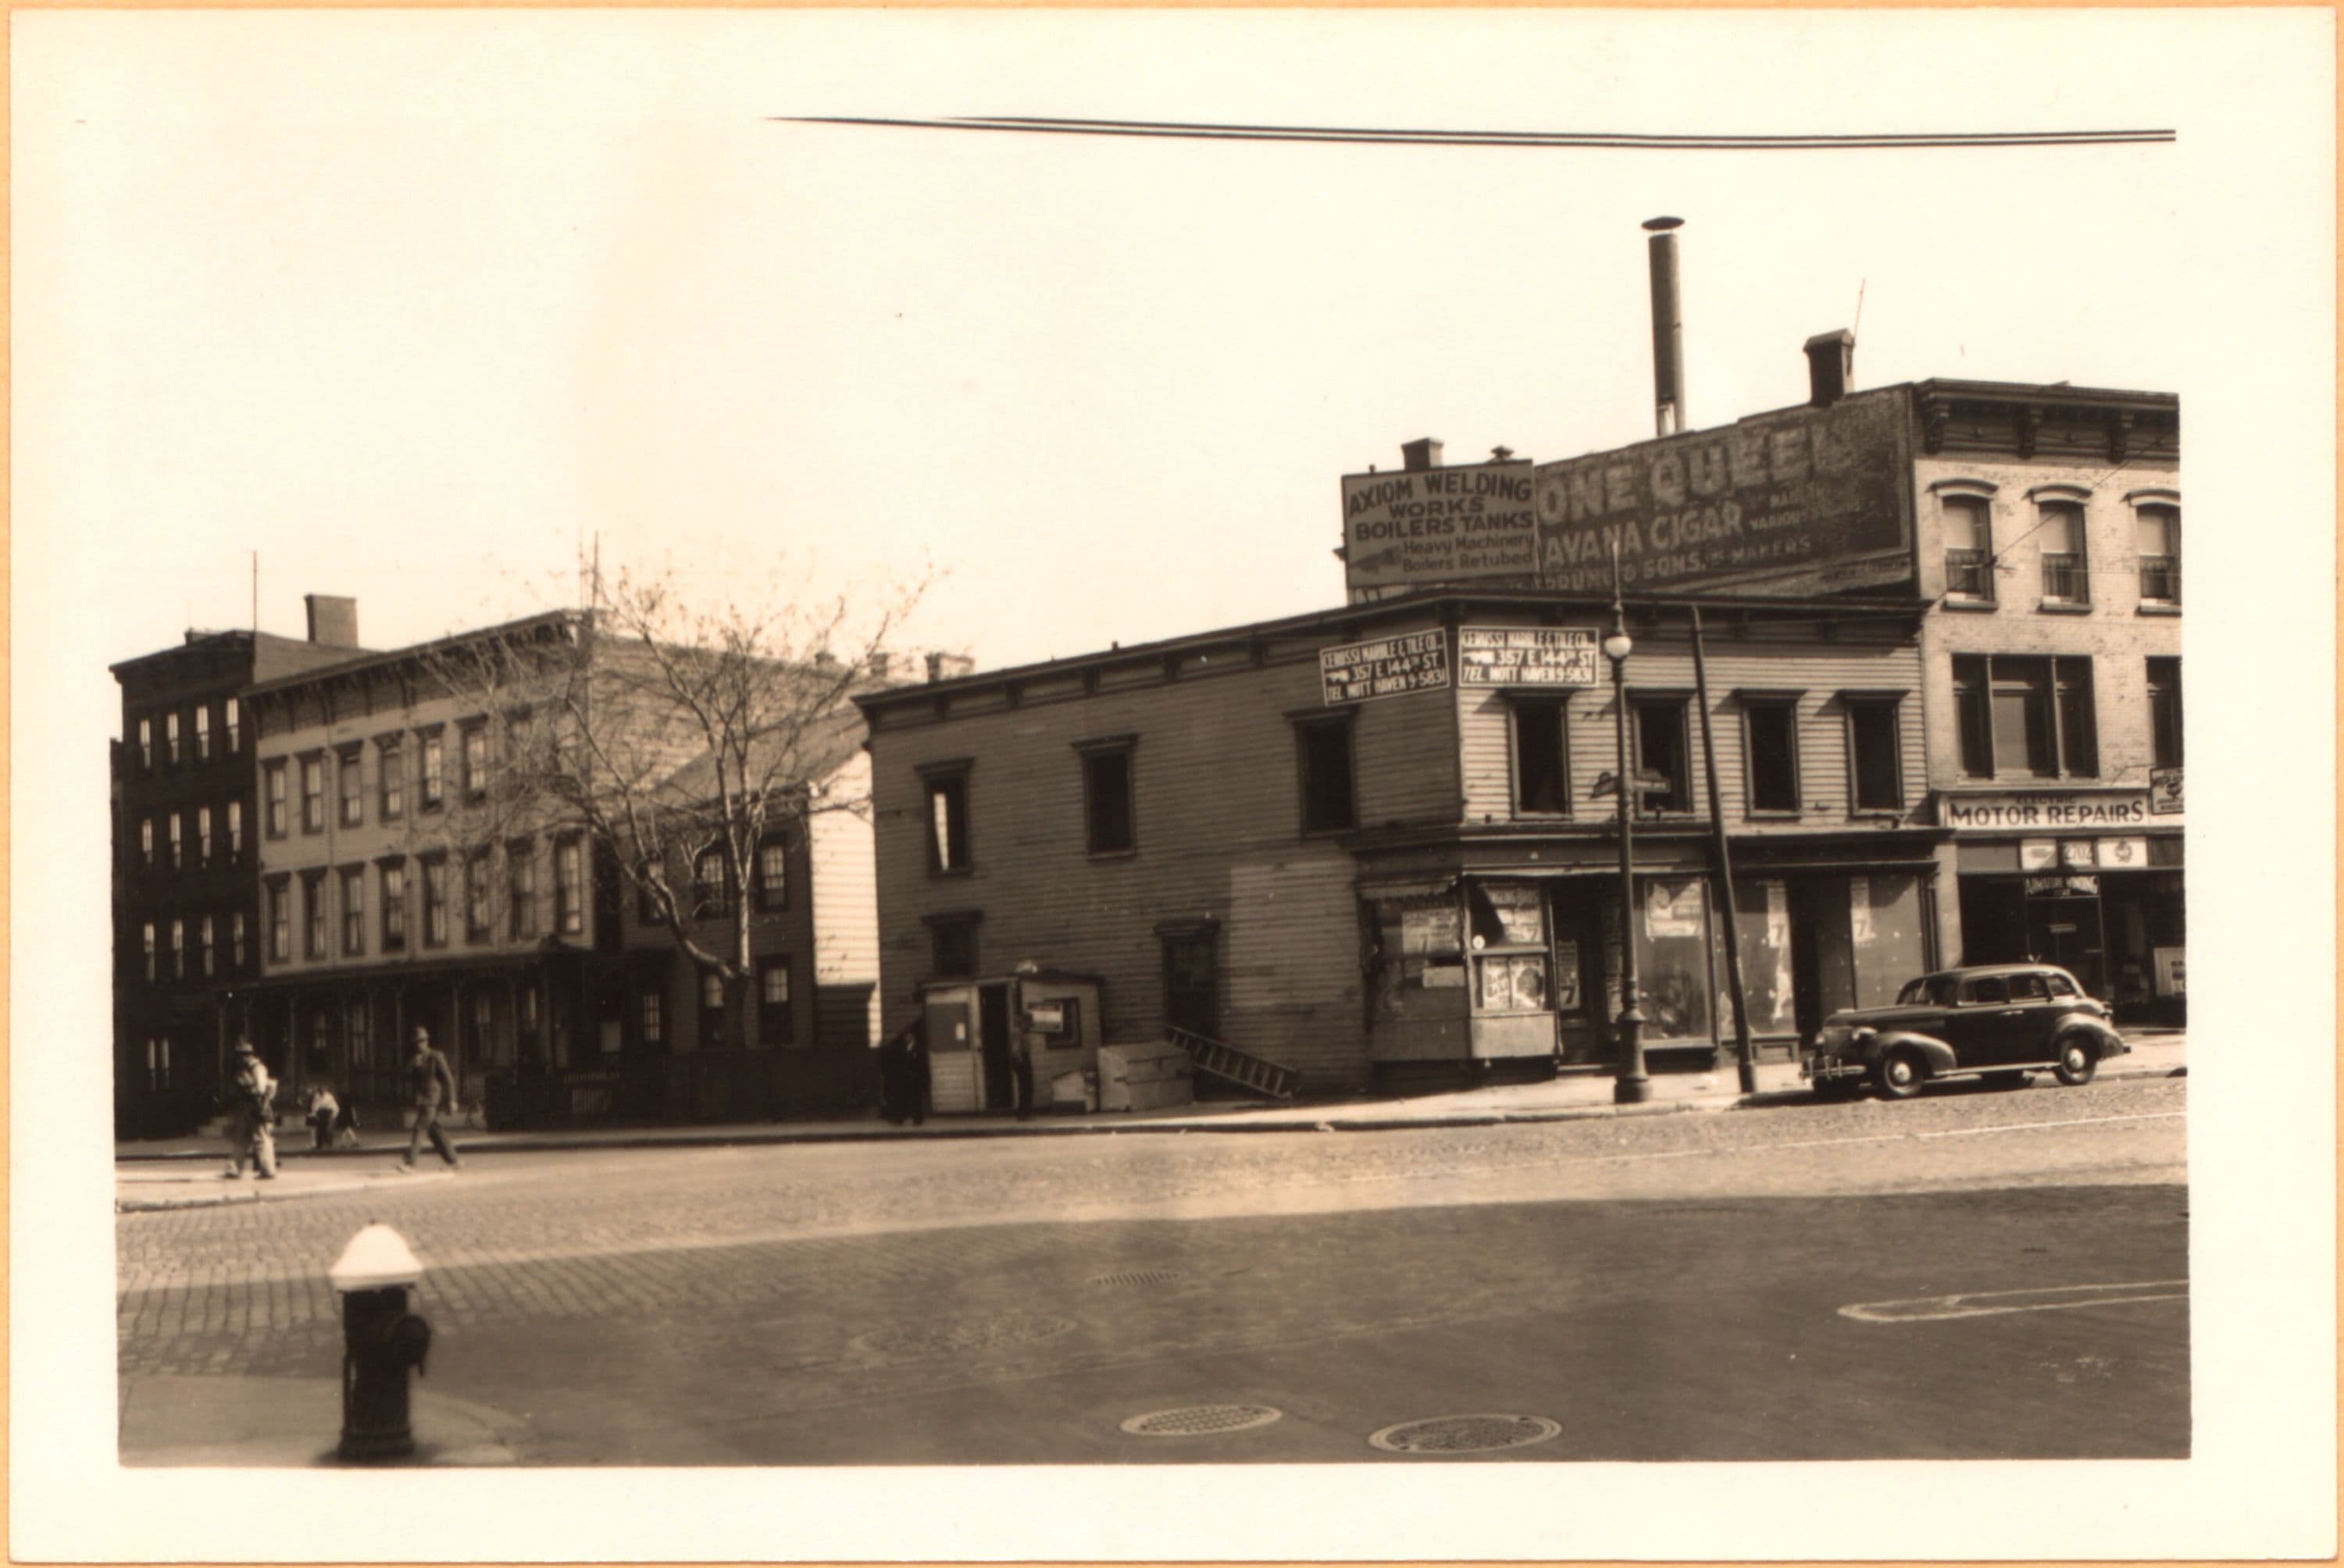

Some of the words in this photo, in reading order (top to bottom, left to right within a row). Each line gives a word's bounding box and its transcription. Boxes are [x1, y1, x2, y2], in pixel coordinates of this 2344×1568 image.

[1348, 477, 1414, 518] AXIOM
[1425, 472, 1533, 502] WELDING
[1389, 496, 1486, 519] WORKS
[1355, 516, 1455, 541] BOILERS
[1460, 510, 1534, 533] TANKS
[1650, 497, 1744, 551] CIGAR
[1404, 540, 1453, 555] Heavy
[1454, 533, 1535, 551] Machinery
[1404, 558, 1454, 572] Boilers
[1459, 551, 1533, 570] Retubed
[1350, 663, 1373, 682] 357
[1375, 661, 1384, 679] E
[1422, 651, 1439, 669] ST
[1497, 649, 1525, 665] 357
[1526, 649, 1536, 665] E
[1579, 649, 1595, 666] ST
[1489, 665, 1519, 682] MOTT
[1521, 665, 1556, 682] HAVEN
[1346, 680, 1372, 699] MOTT
[1374, 675, 1407, 695] HAVEN
[2015, 795, 2076, 805] ELECTRIC
[1950, 803, 2039, 826] MOTOR
[2046, 800, 2144, 825] REPAIRS
[1561, 985, 1576, 1005] 7
